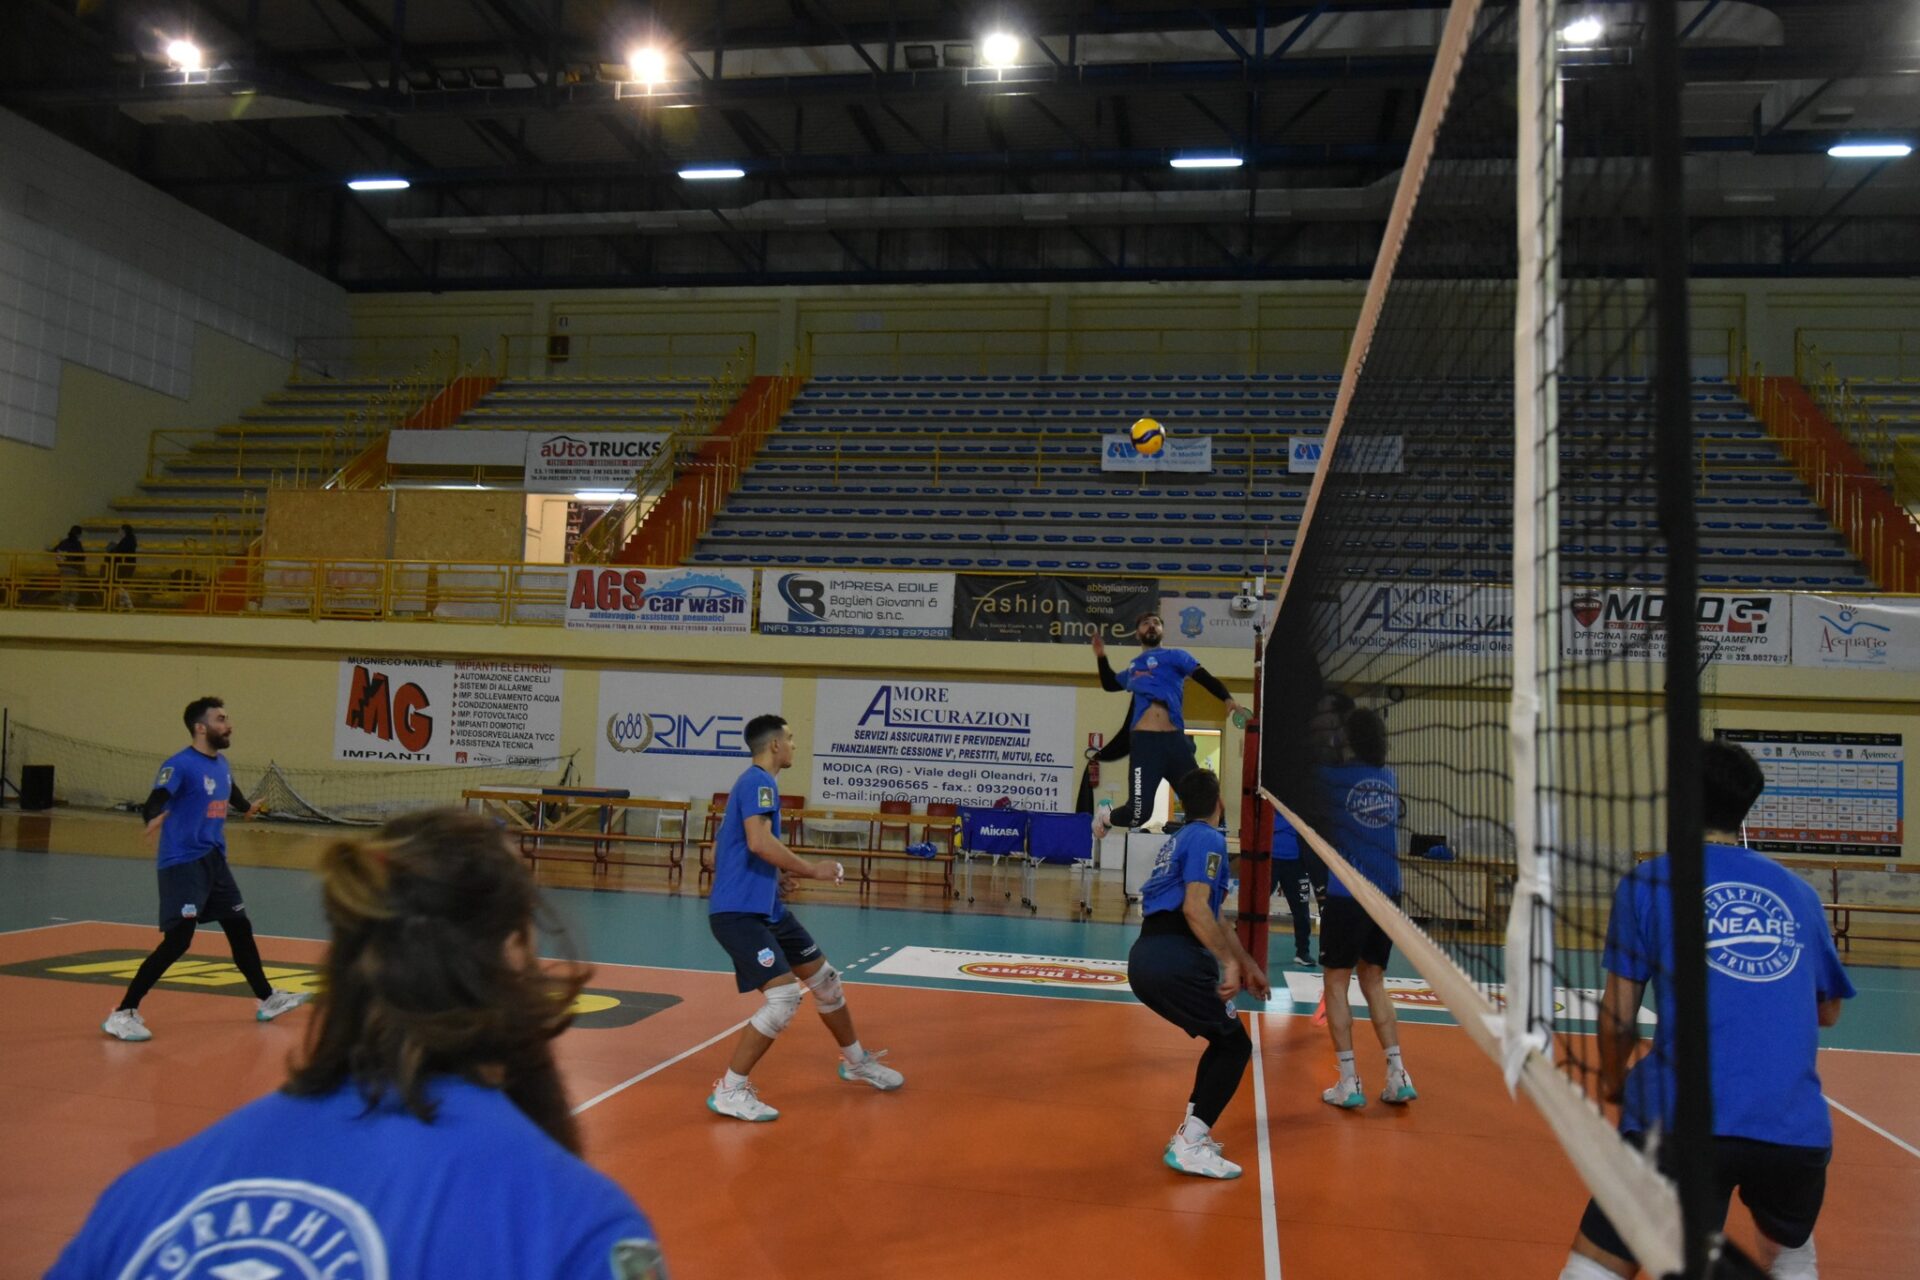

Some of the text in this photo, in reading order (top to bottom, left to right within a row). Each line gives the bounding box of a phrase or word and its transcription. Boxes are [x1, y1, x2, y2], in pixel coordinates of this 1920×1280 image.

[570, 569, 647, 611] AGS
[829, 580, 938, 593] IMPRESA EDILE
[1086, 583, 1149, 593] abbigliamento
[650, 595, 744, 613] car wash
[876, 597, 925, 608] Giovanni
[1086, 595, 1112, 604] uomo
[828, 608, 874, 620] Antonio
[1086, 605, 1114, 614] donna
[1604, 594, 1725, 623] MOO
[763, 624, 789, 633] INFO
[1049, 620, 1136, 638] amore
[1574, 630, 1621, 640] OFFICINA
[403, 659, 443, 668] NATALE
[454, 660, 552, 674] IMPIANTI ELETTRICI
[460, 672, 551, 683] AUTOMAZIONE CANCELLI
[459, 682, 488, 690] SISTEMI
[498, 683, 533, 692] ALLARME
[474, 692, 533, 701] SOLLEVAMENTO
[533, 694, 560, 702] ACQUA
[345, 665, 433, 752] MG
[458, 701, 528, 711] CONDIZIONAMENTO
[473, 711, 528, 720] FOTOVOLTAICO
[456, 720, 525, 730] IMPIANTI DOMOTICI
[615, 712, 643, 743] 1988
[455, 729, 555, 741] VIDEOSORVEGLIANZA TVCC
[854, 730, 1031, 748] SERVIZI ASSICURATIVI E PREVIDENZIALI
[455, 739, 534, 750] ASSISTENZA TECNICA
[343, 749, 430, 761] IMPIANTI
[831, 743, 899, 757] FINANZIAMENTI:
[900, 746, 943, 758] CESSIONE
[958, 751, 999, 762] PRESTITI,
[1001, 752, 1032, 764] MUTUI,
[1034, 752, 1055, 763] ECC.
[822, 762, 872, 774] MODICA
[875, 763, 903, 776] (RG)
[914, 766, 944, 778] Viale
[947, 768, 977, 781] degli
[980, 769, 1036, 783] Oleandri,
[1040, 772, 1059, 783] 7/a
[823, 776, 843, 786] tel.
[848, 777, 929, 790] 0932906565
[976, 783, 1059, 797] 0932906011
[1134, 767, 1142, 819] VOLLEY MODICA
[1704, 888, 1783, 917] GRAPHIC
[1707, 917, 1796, 938] NEARE
[1716, 951, 1790, 974] PRINTING
